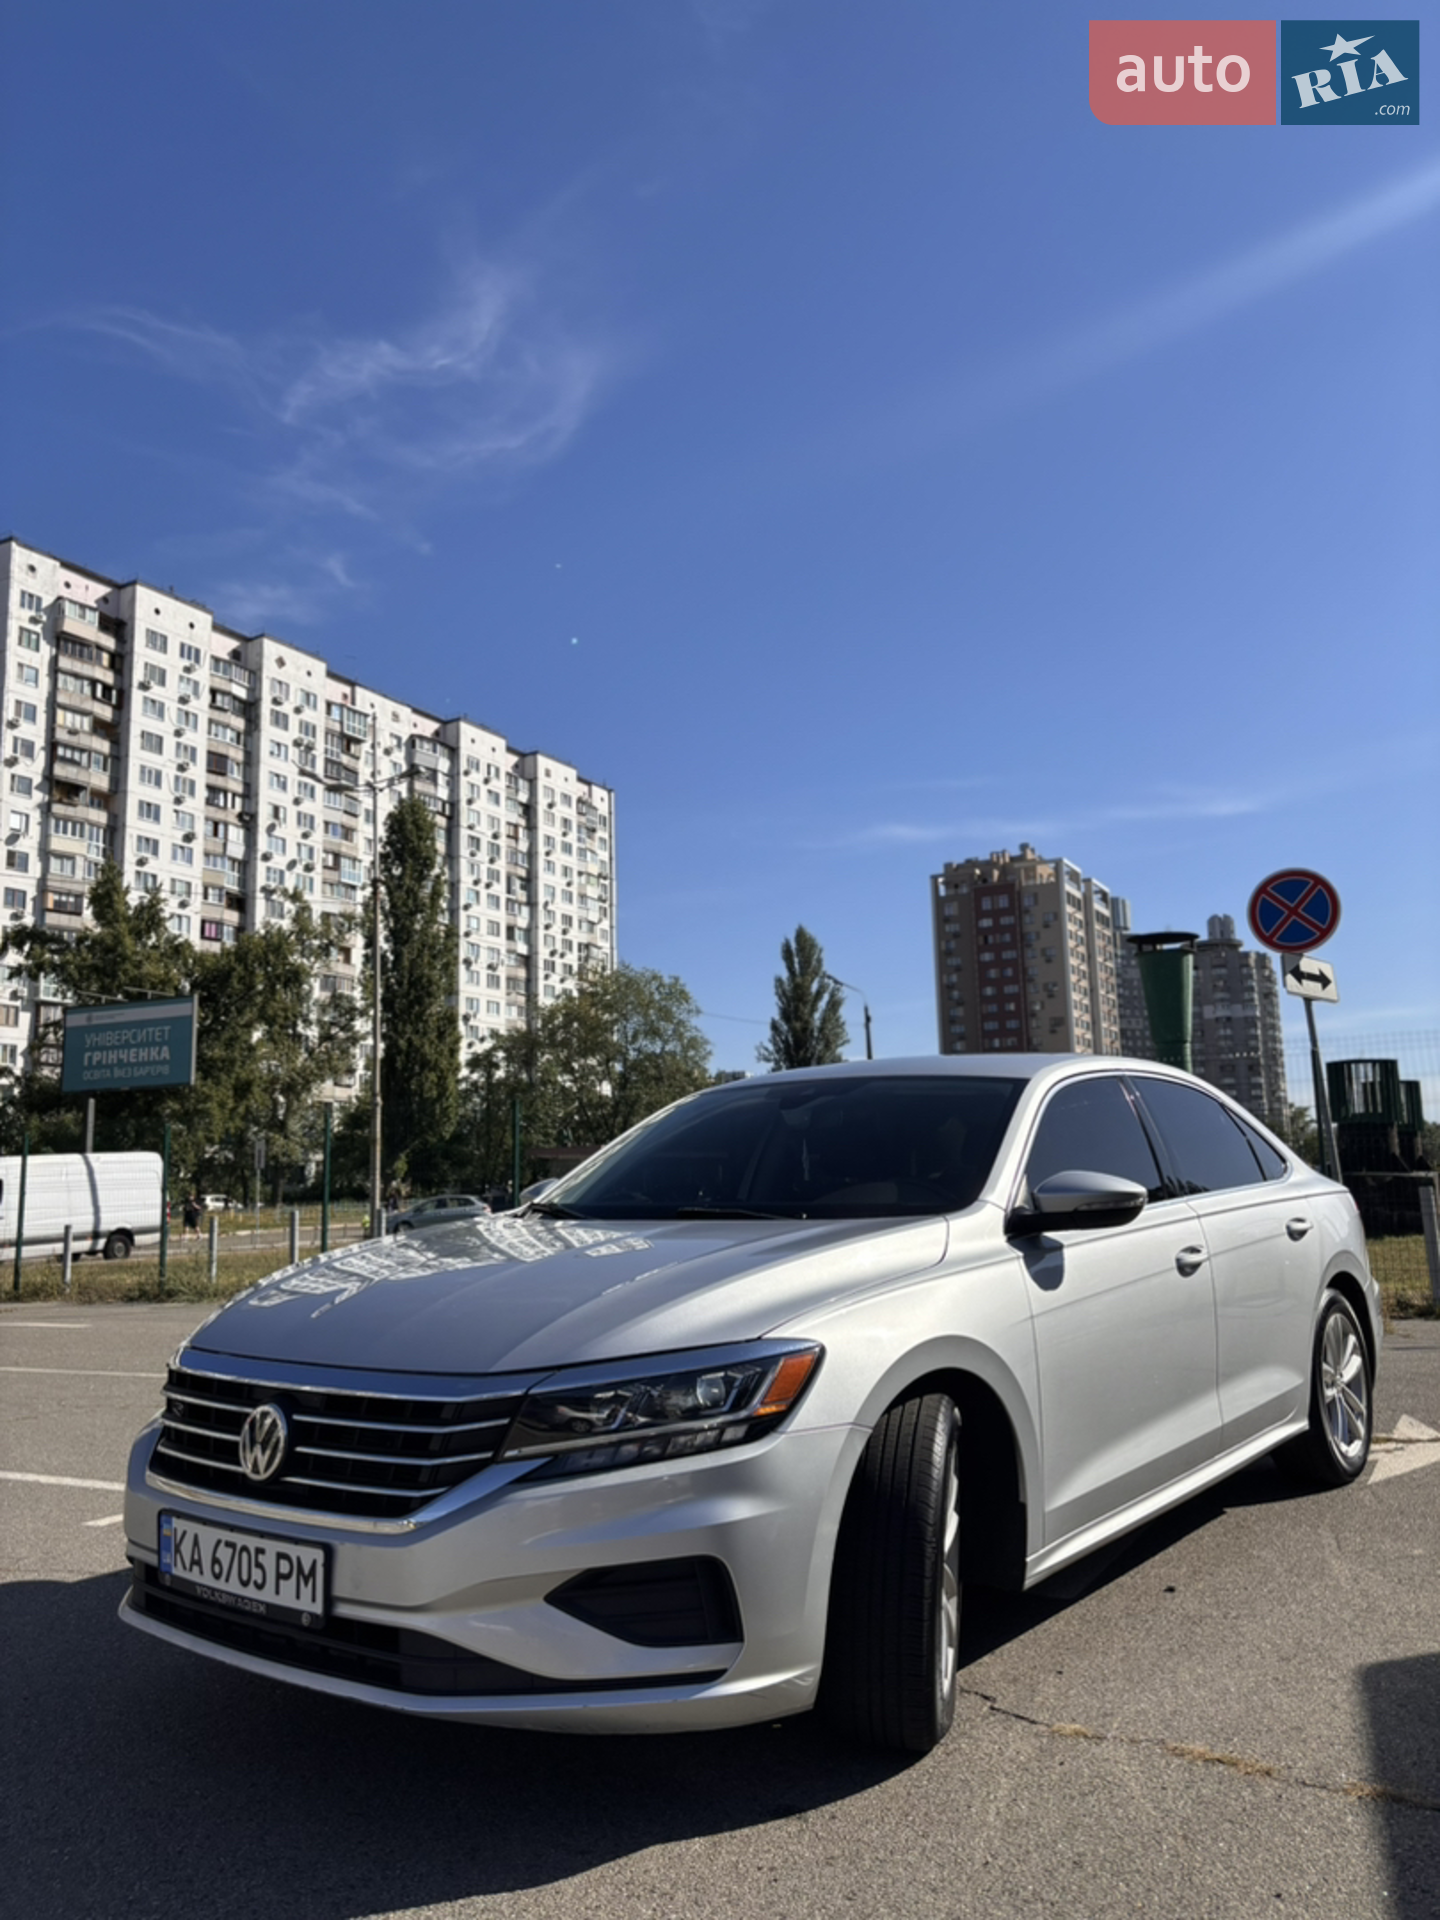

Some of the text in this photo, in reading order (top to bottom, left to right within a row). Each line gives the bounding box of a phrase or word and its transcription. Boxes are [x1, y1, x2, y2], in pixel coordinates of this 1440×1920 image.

[85, 1026, 171, 1047] УНІВЕРСИТЕТ
[84, 1046, 170, 1066] ГРІНЧЕНКА
[173, 1527, 318, 1604] KA 6705 PM
